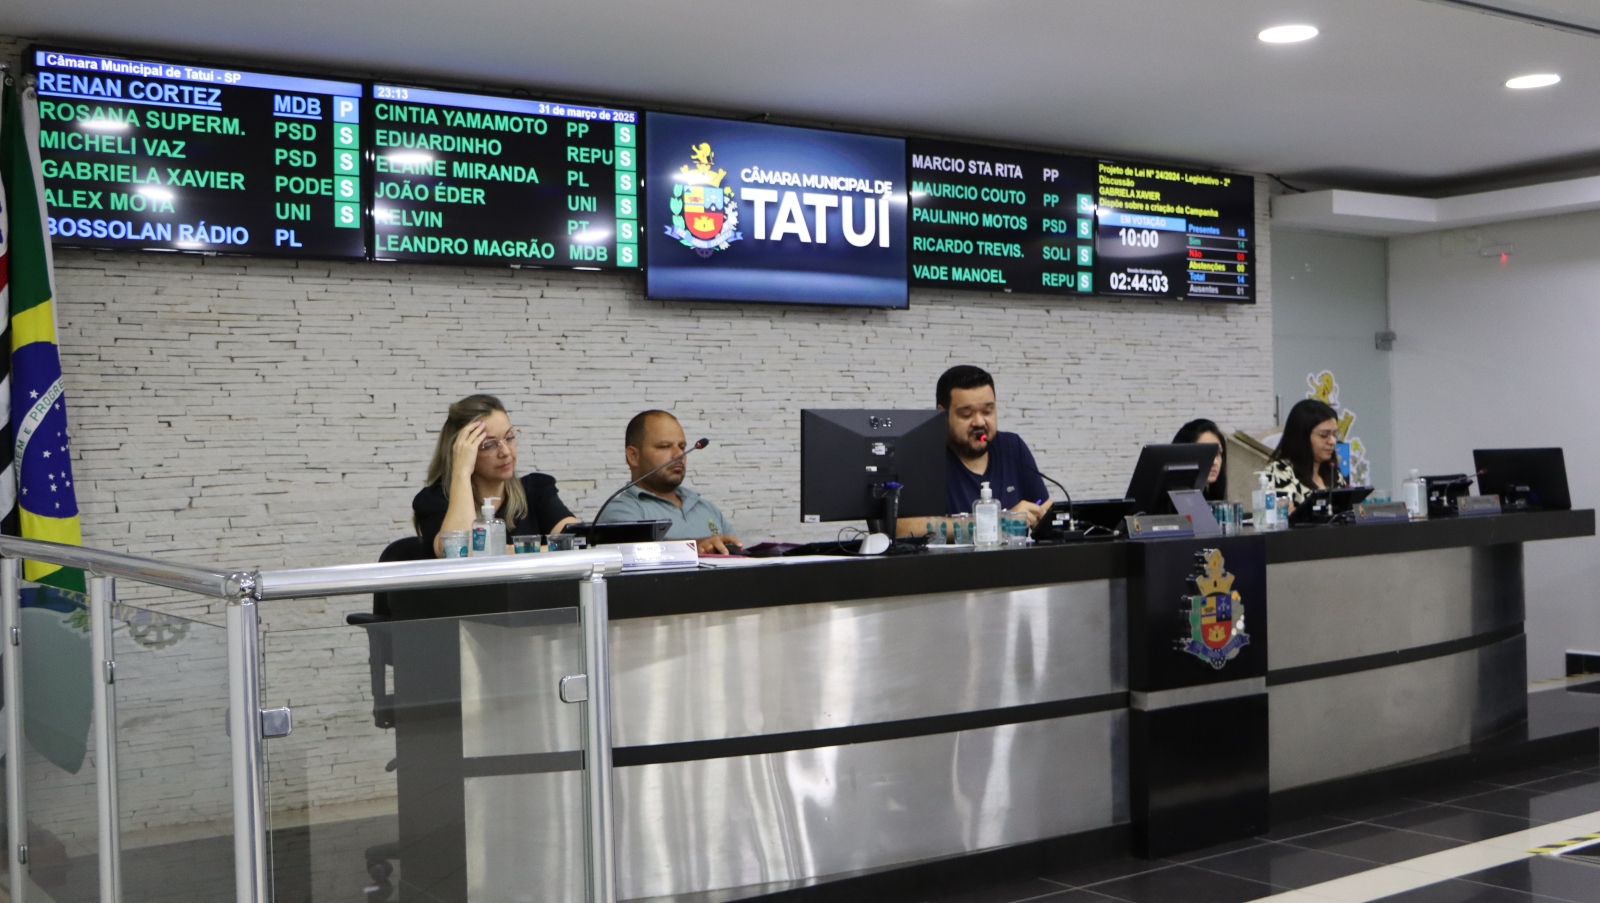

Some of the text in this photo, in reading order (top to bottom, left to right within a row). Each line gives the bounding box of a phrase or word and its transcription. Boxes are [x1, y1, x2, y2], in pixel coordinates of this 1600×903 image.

[47, 54, 98, 71] Câmara
[101, 60, 163, 77] Municipal
[165, 67, 181, 78] de
[184, 68, 214, 81] Tatuí
[224, 72, 241, 83] SP
[38, 72, 353, 117] RENAN CORTEZ MDB P
[378, 88, 408, 99] 23:13
[40, 101, 353, 144] ROSANA SUPERM. PSD S
[375, 104, 631, 142] CINTIA YAMAMOTO PP S
[539, 104, 635, 122] 31 de março de 2025
[40, 131, 353, 171] MICHELI VAZ PSD S
[376, 129, 631, 166] EDUARDINHO REPU S
[41, 160, 354, 197] GABRIELA XAVIER PODE S
[376, 156, 631, 190] ELAINE MIRANDA PL S
[741, 166, 892, 195] CÂMARA MUNICIPAL DE
[912, 154, 1059, 182] MARCIO STA RITA PP
[1099, 164, 1123, 176] Projeto
[1135, 168, 1145, 177] Lei
[1155, 170, 1180, 181] 24/2024
[1185, 173, 1219, 187] Legislativo
[1099, 176, 1135, 187] Discussão
[1099, 187, 1161, 201] GABRIELA XAVIER
[44, 188, 354, 223] ALEX MOTA UNI S
[375, 180, 632, 214] JOÃO ÉDER UNI S
[912, 182, 1089, 211] MAURICIO COUTO PP S
[1099, 198, 1123, 208] Dispõe
[1125, 201, 1144, 211] sobre
[1151, 204, 1174, 214] criação
[1175, 205, 1184, 214] da
[1185, 206, 1219, 217] Campanha
[375, 209, 632, 239] KELVIN PT S
[741, 188, 890, 248] TATUÍ
[913, 209, 1089, 236] PAULINHO MOTOS PSD S
[1120, 216, 1166, 227] EM VOTAÇÃO
[1188, 224, 1220, 235] Presentes
[48, 218, 302, 247] BOSSOLAN RÁDIO PL
[1119, 228, 1159, 248] 10:00
[1189, 237, 1201, 246] Sim
[375, 235, 633, 263] LEANDRO MAGRÃO MDB S
[913, 237, 1089, 263] RICARDO TREVIS. SOLI S
[1189, 250, 1245, 261] Não 00
[913, 265, 1089, 289] VADE MANOEL REPU S
[1189, 261, 1226, 272] Abstenções
[1189, 272, 1205, 282] Total
[1110, 272, 1169, 292] 02:44:03
[1189, 284, 1244, 295] Ausentes 01
[24, 427, 31, 435] E
